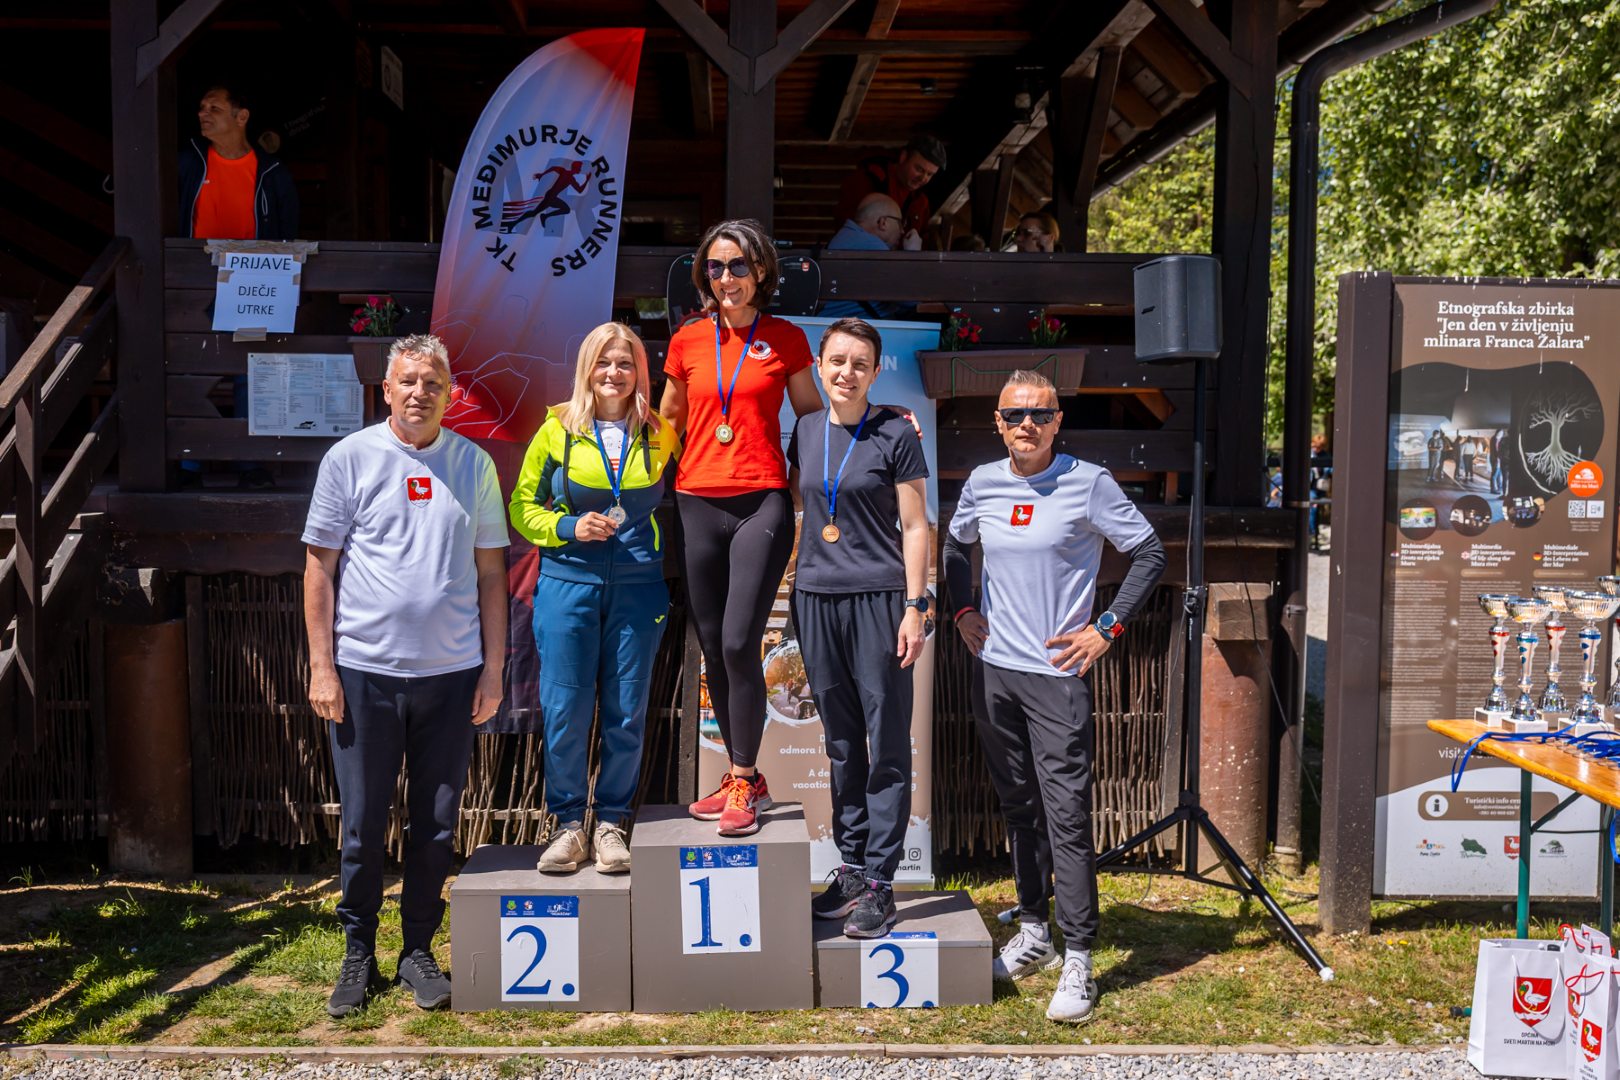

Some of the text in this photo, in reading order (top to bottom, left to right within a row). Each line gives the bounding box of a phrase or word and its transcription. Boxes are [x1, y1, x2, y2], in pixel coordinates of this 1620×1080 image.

[472, 124, 618, 277] TK MEĐIMURJE RUNNERS
[230, 255, 292, 271] PRIJAVE
[238, 284, 277, 298] DJEČJE
[237, 304, 275, 315] UTRKE
[1438, 300, 1575, 317] Etnografska zbirka
[1469, 318, 1497, 331] den
[1499, 321, 1508, 332] v
[1511, 318, 1575, 335] življenju
[1424, 334, 1481, 348] mlinara
[1485, 335, 1535, 349] Franca
[780, 745, 816, 755] odmora
[808, 768, 816, 778] A
[687, 876, 753, 949] 1.
[504, 924, 577, 997] 2.
[866, 942, 935, 1008] 3.
